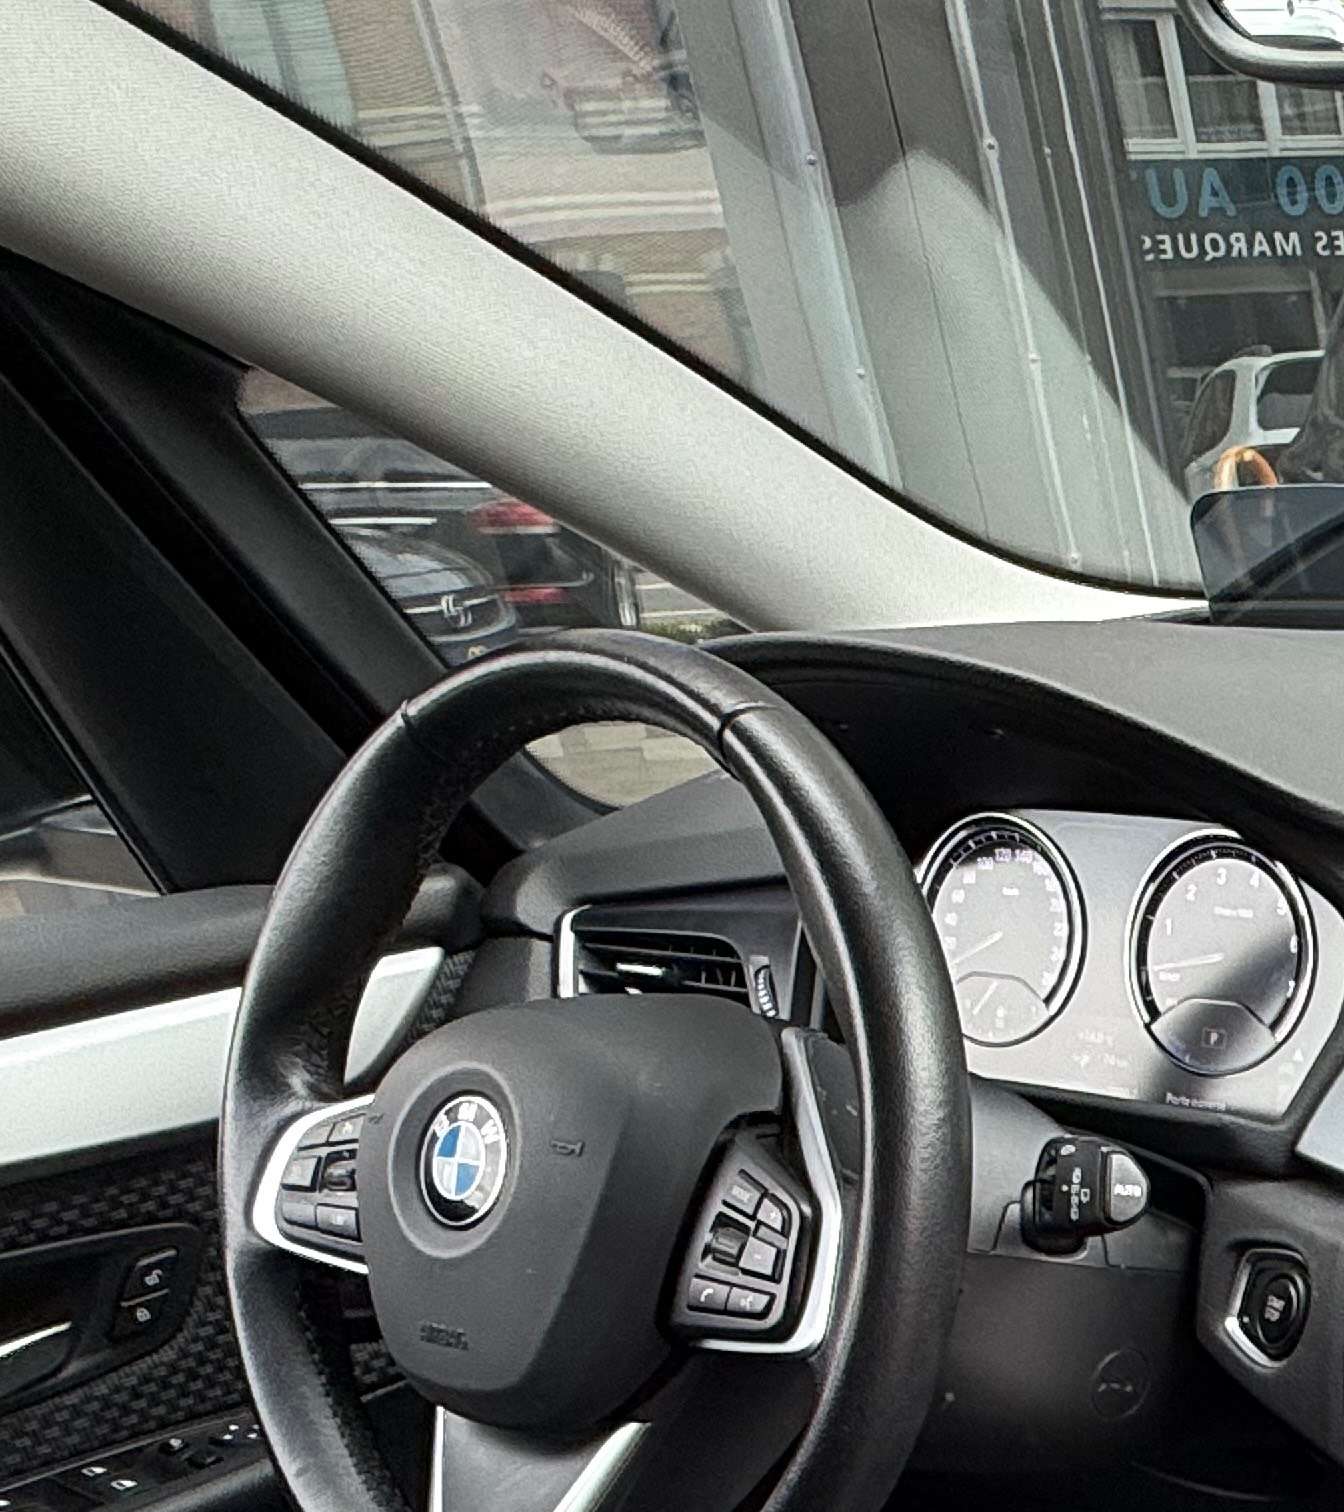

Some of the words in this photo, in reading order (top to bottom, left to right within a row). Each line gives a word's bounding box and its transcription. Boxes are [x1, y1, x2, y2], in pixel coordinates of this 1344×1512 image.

[1216, 867, 1227, 886] 3
[1250, 869, 1261, 888] 4
[1186, 884, 1197, 902] 2
[1165, 918, 1173, 936] 1
